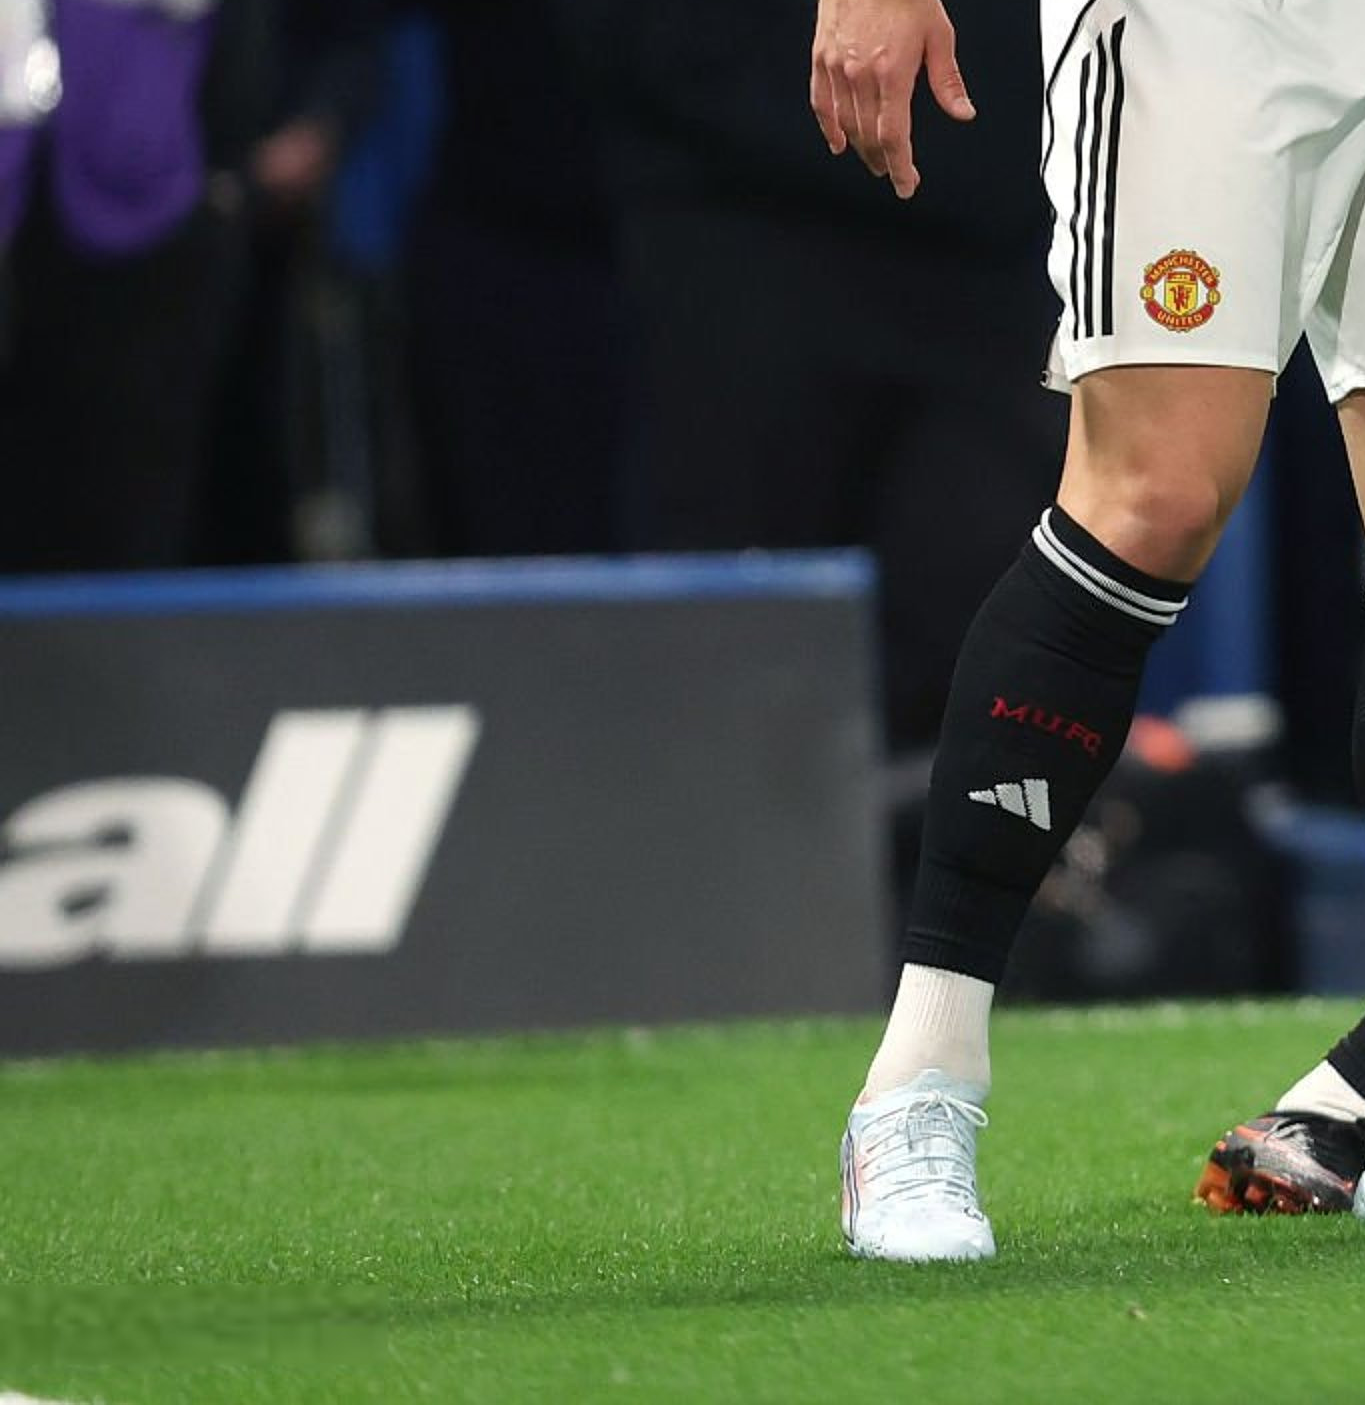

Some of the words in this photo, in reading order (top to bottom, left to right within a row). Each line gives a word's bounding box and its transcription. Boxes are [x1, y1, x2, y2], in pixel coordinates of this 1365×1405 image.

[1151, 255, 1214, 285] MANCHESTER
[1157, 311, 1203, 326] UNITED
[0, 704, 482, 971] all
